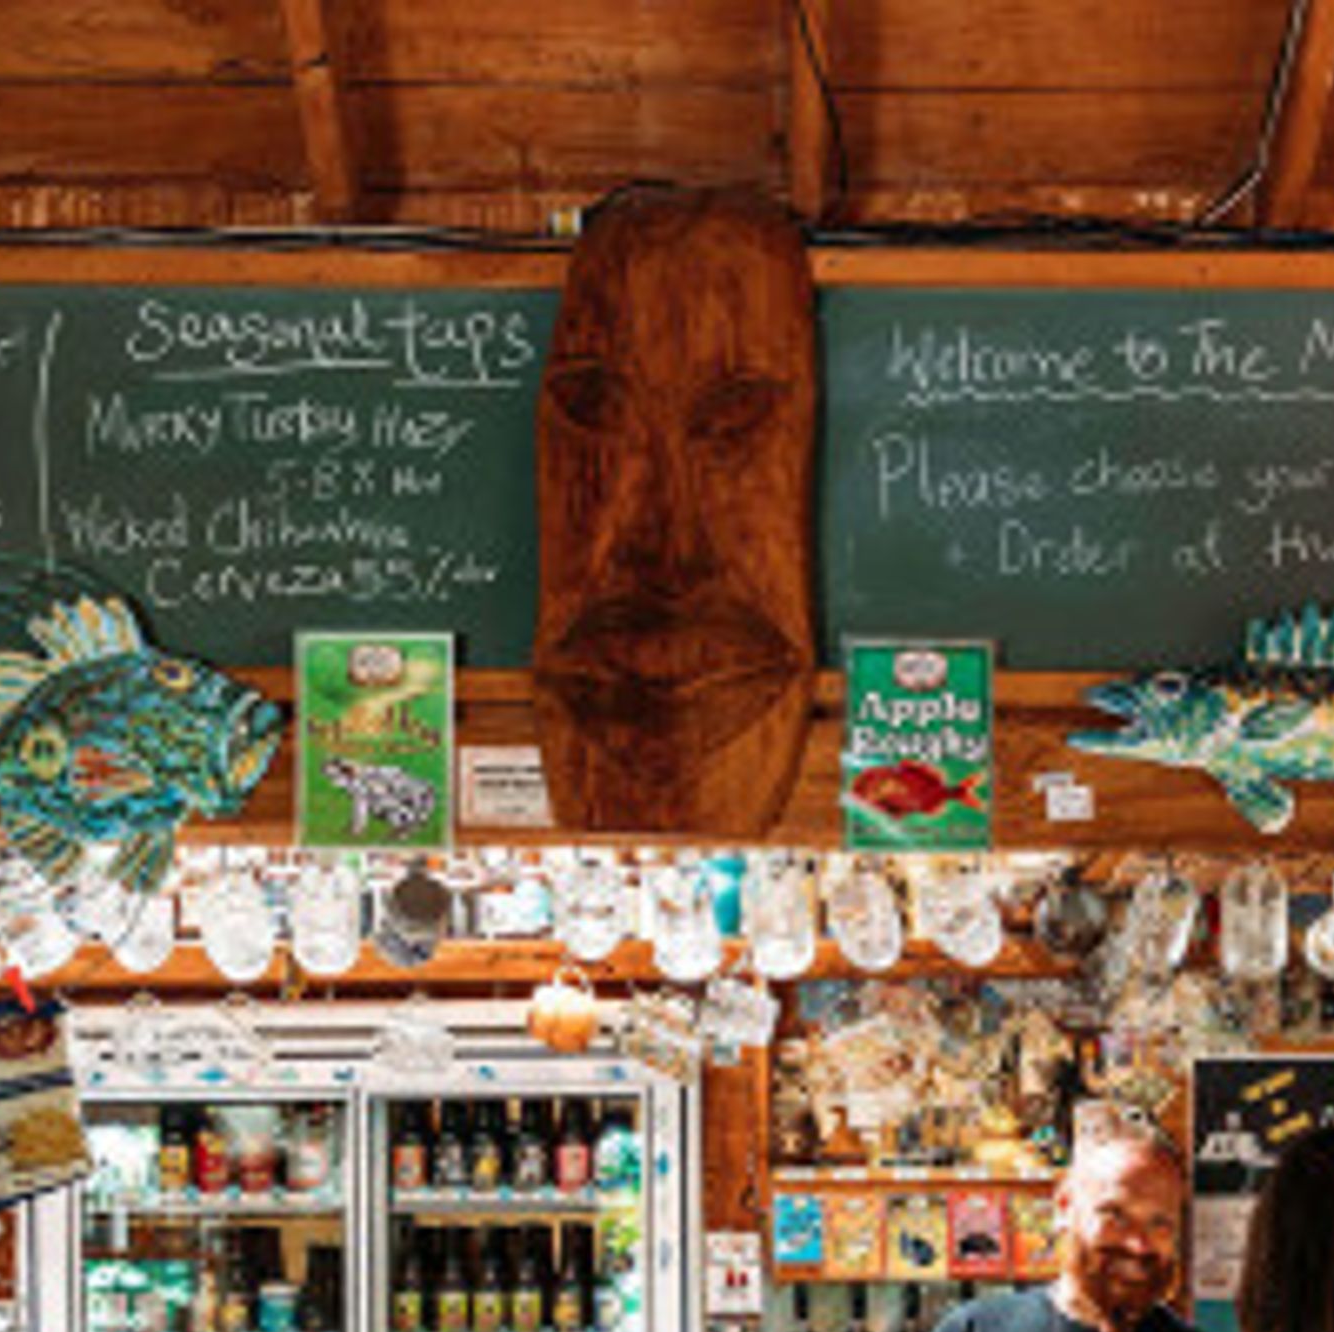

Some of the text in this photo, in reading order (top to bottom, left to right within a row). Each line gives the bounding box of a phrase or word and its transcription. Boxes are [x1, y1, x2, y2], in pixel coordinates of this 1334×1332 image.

[126, 299, 536, 382] Seasonal taps
[886, 321, 1095, 388] Welcome
[1114, 332, 1168, 380] to
[872, 432, 1050, 520] Please
[1071, 446, 1219, 496] choose
[1236, 458, 1334, 514] your
[859, 691, 981, 728] Apple
